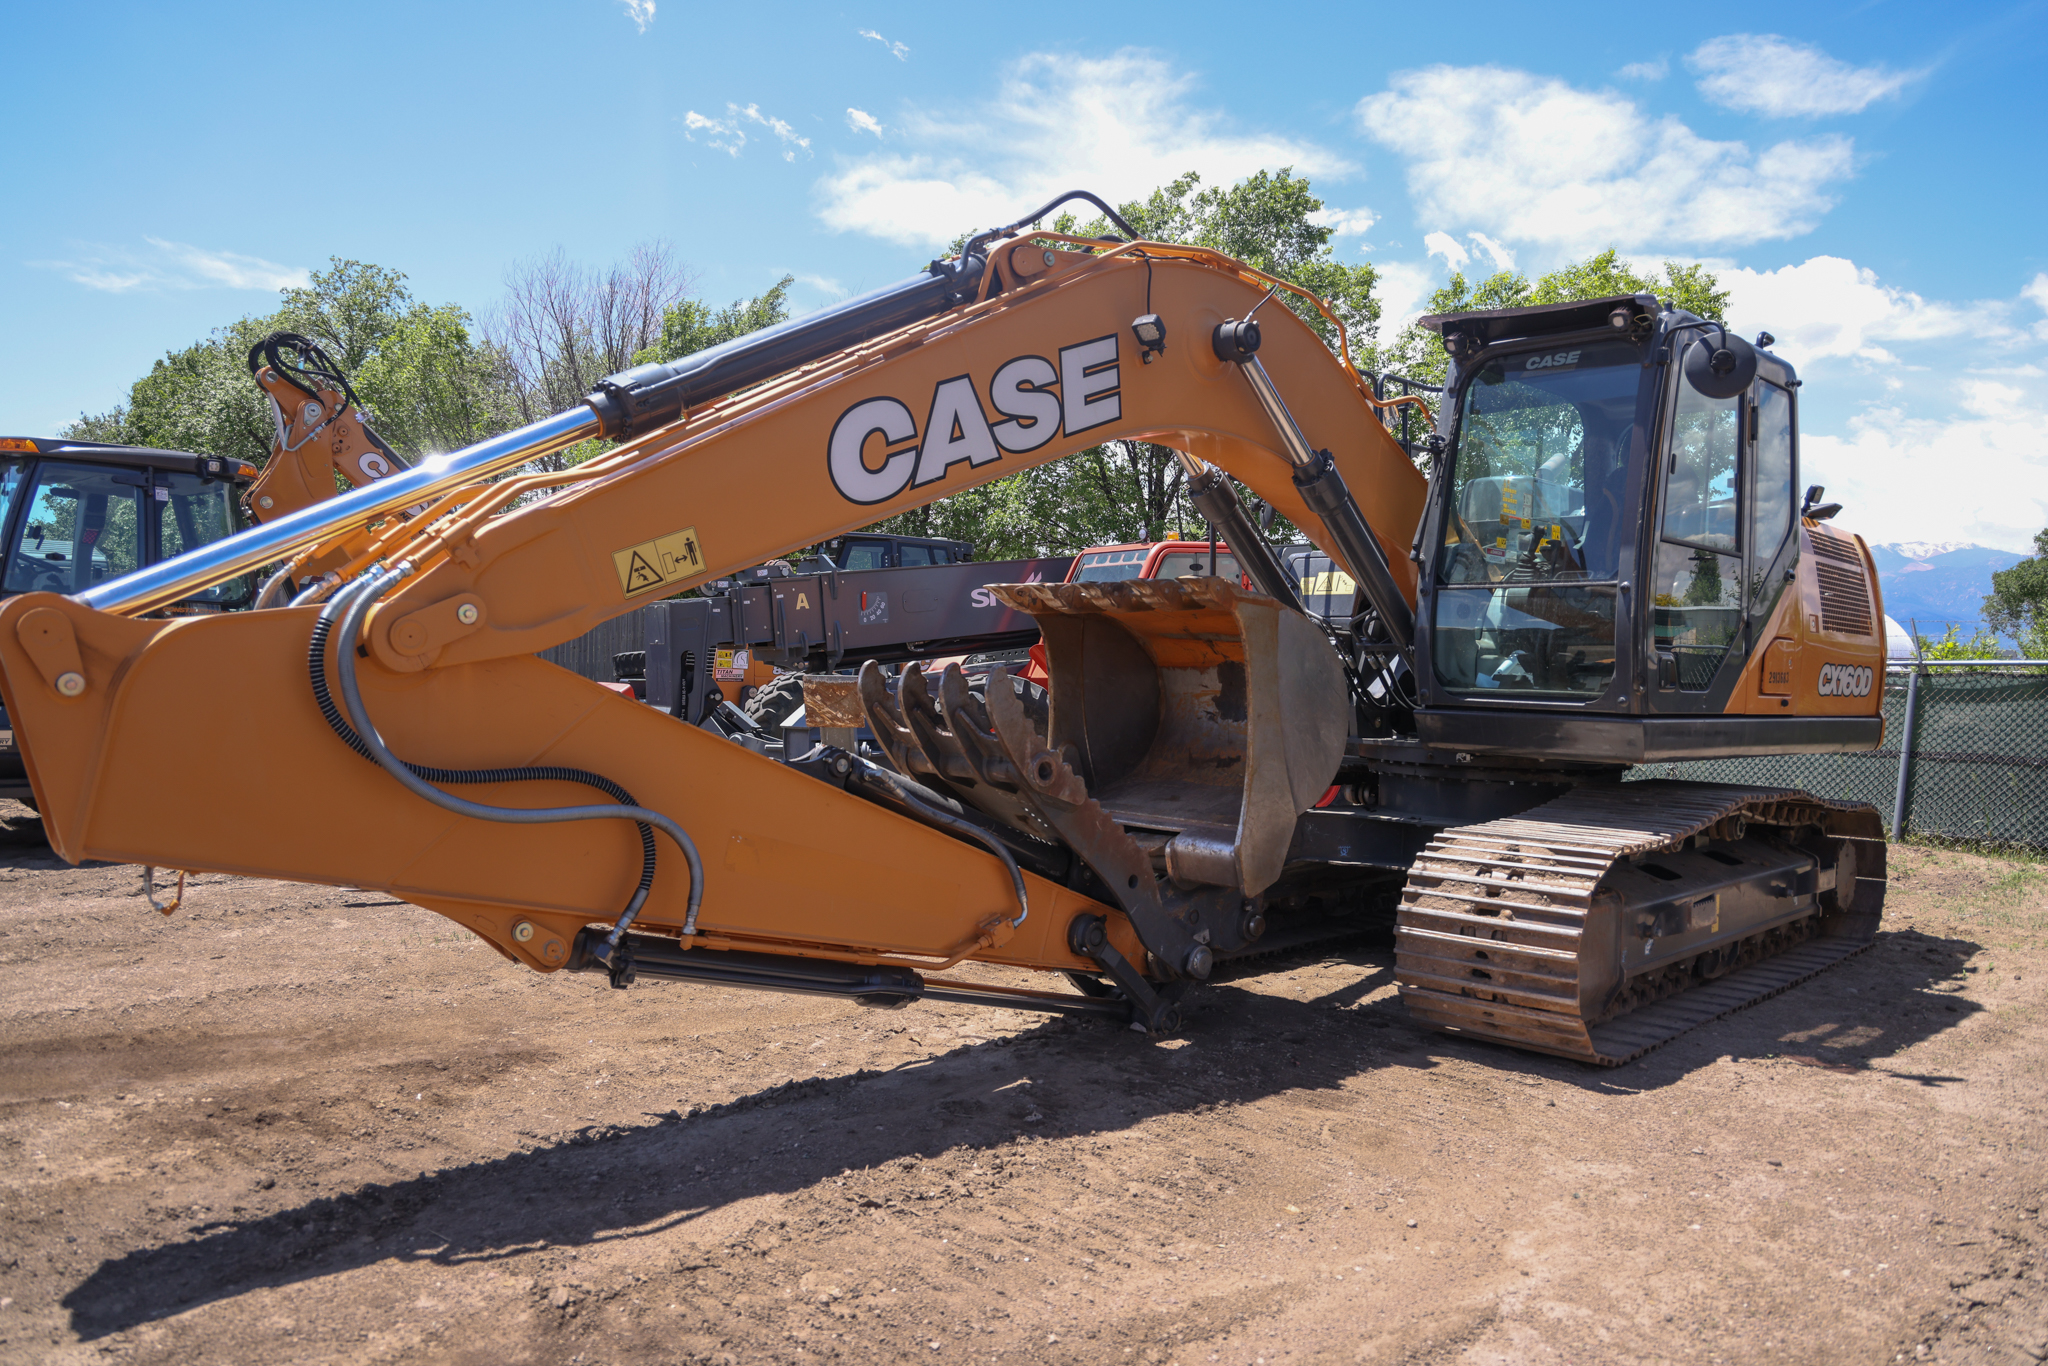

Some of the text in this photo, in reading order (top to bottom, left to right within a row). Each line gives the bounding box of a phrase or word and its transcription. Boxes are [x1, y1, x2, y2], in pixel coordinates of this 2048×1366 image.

[1525, 350, 1581, 370] CASE
[827, 333, 1122, 505] CASE
[796, 593, 809, 610] A
[1817, 662, 1873, 697] CX160D
